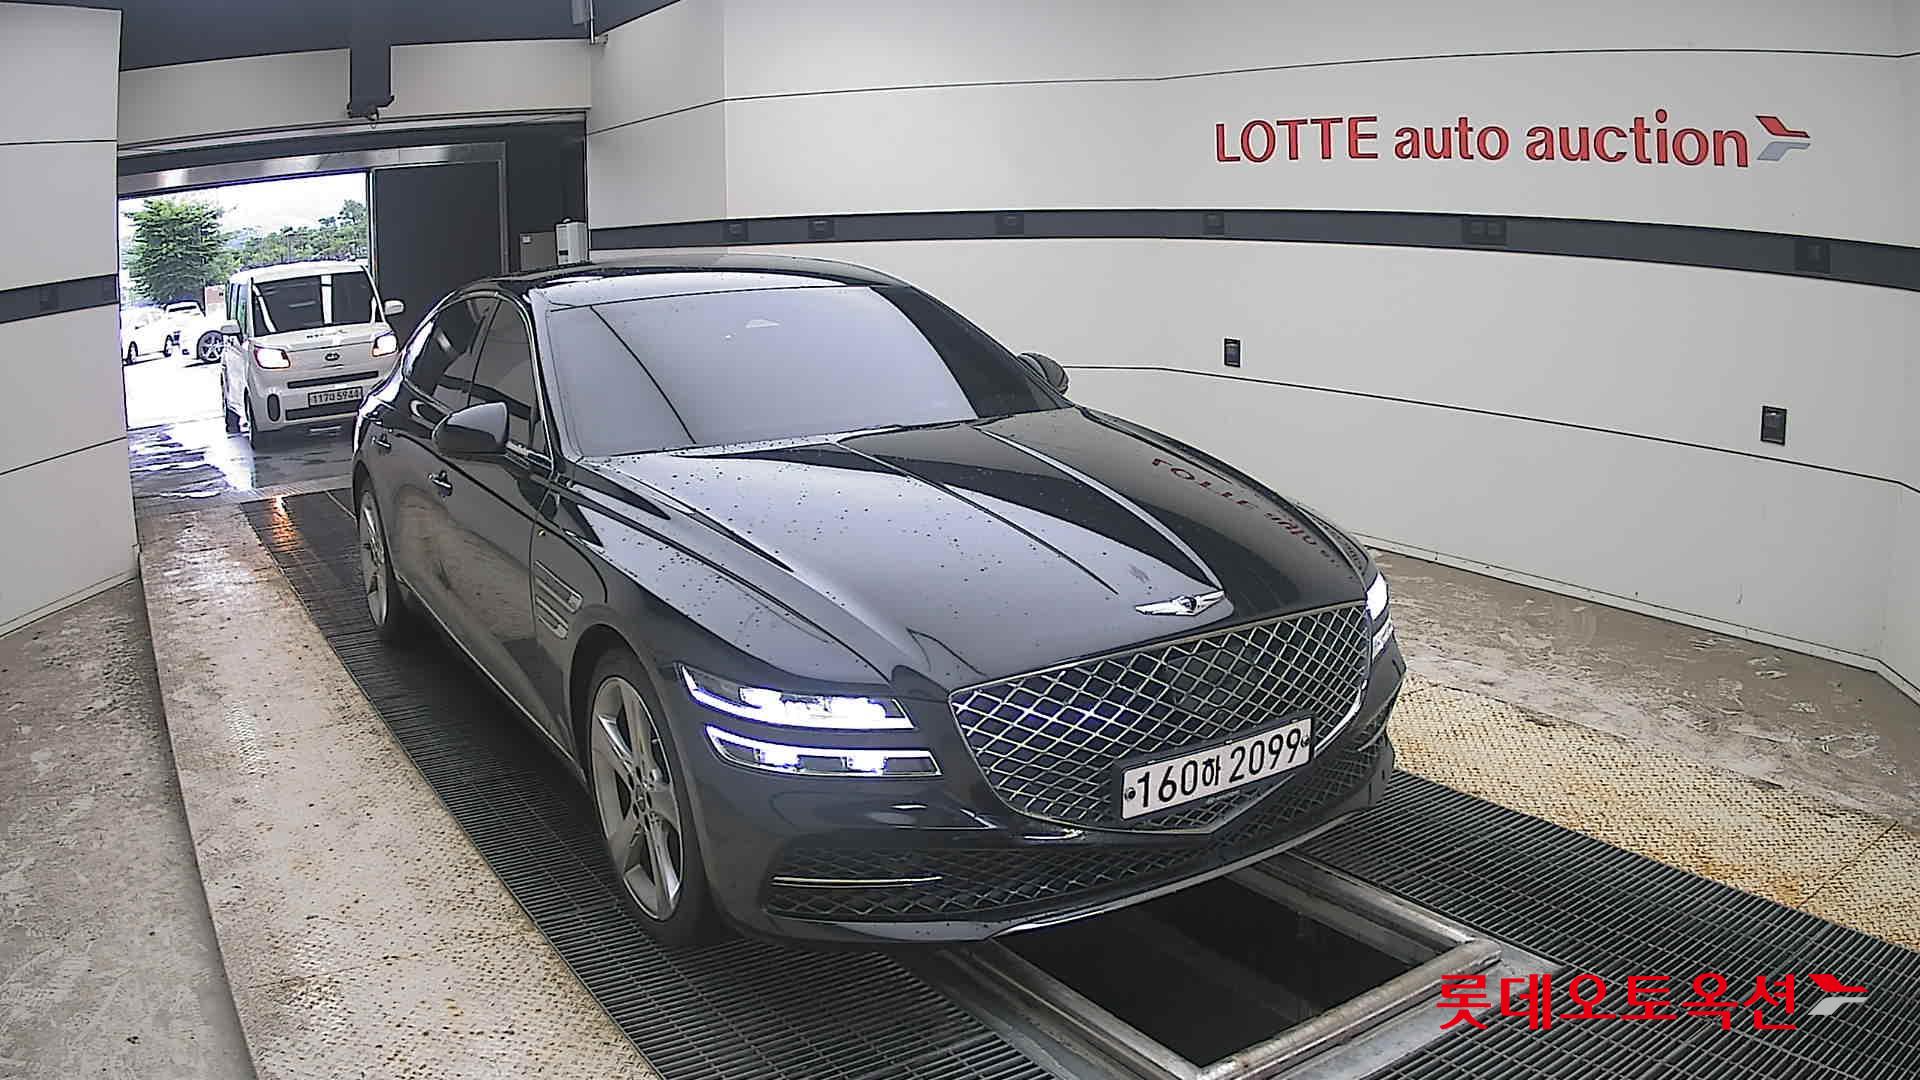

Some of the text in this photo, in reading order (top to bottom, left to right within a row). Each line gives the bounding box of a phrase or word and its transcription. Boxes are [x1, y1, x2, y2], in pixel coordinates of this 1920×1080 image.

[1215, 109, 1750, 167] LOTTE auto auction
[1137, 728, 1302, 808] 160하 2099
